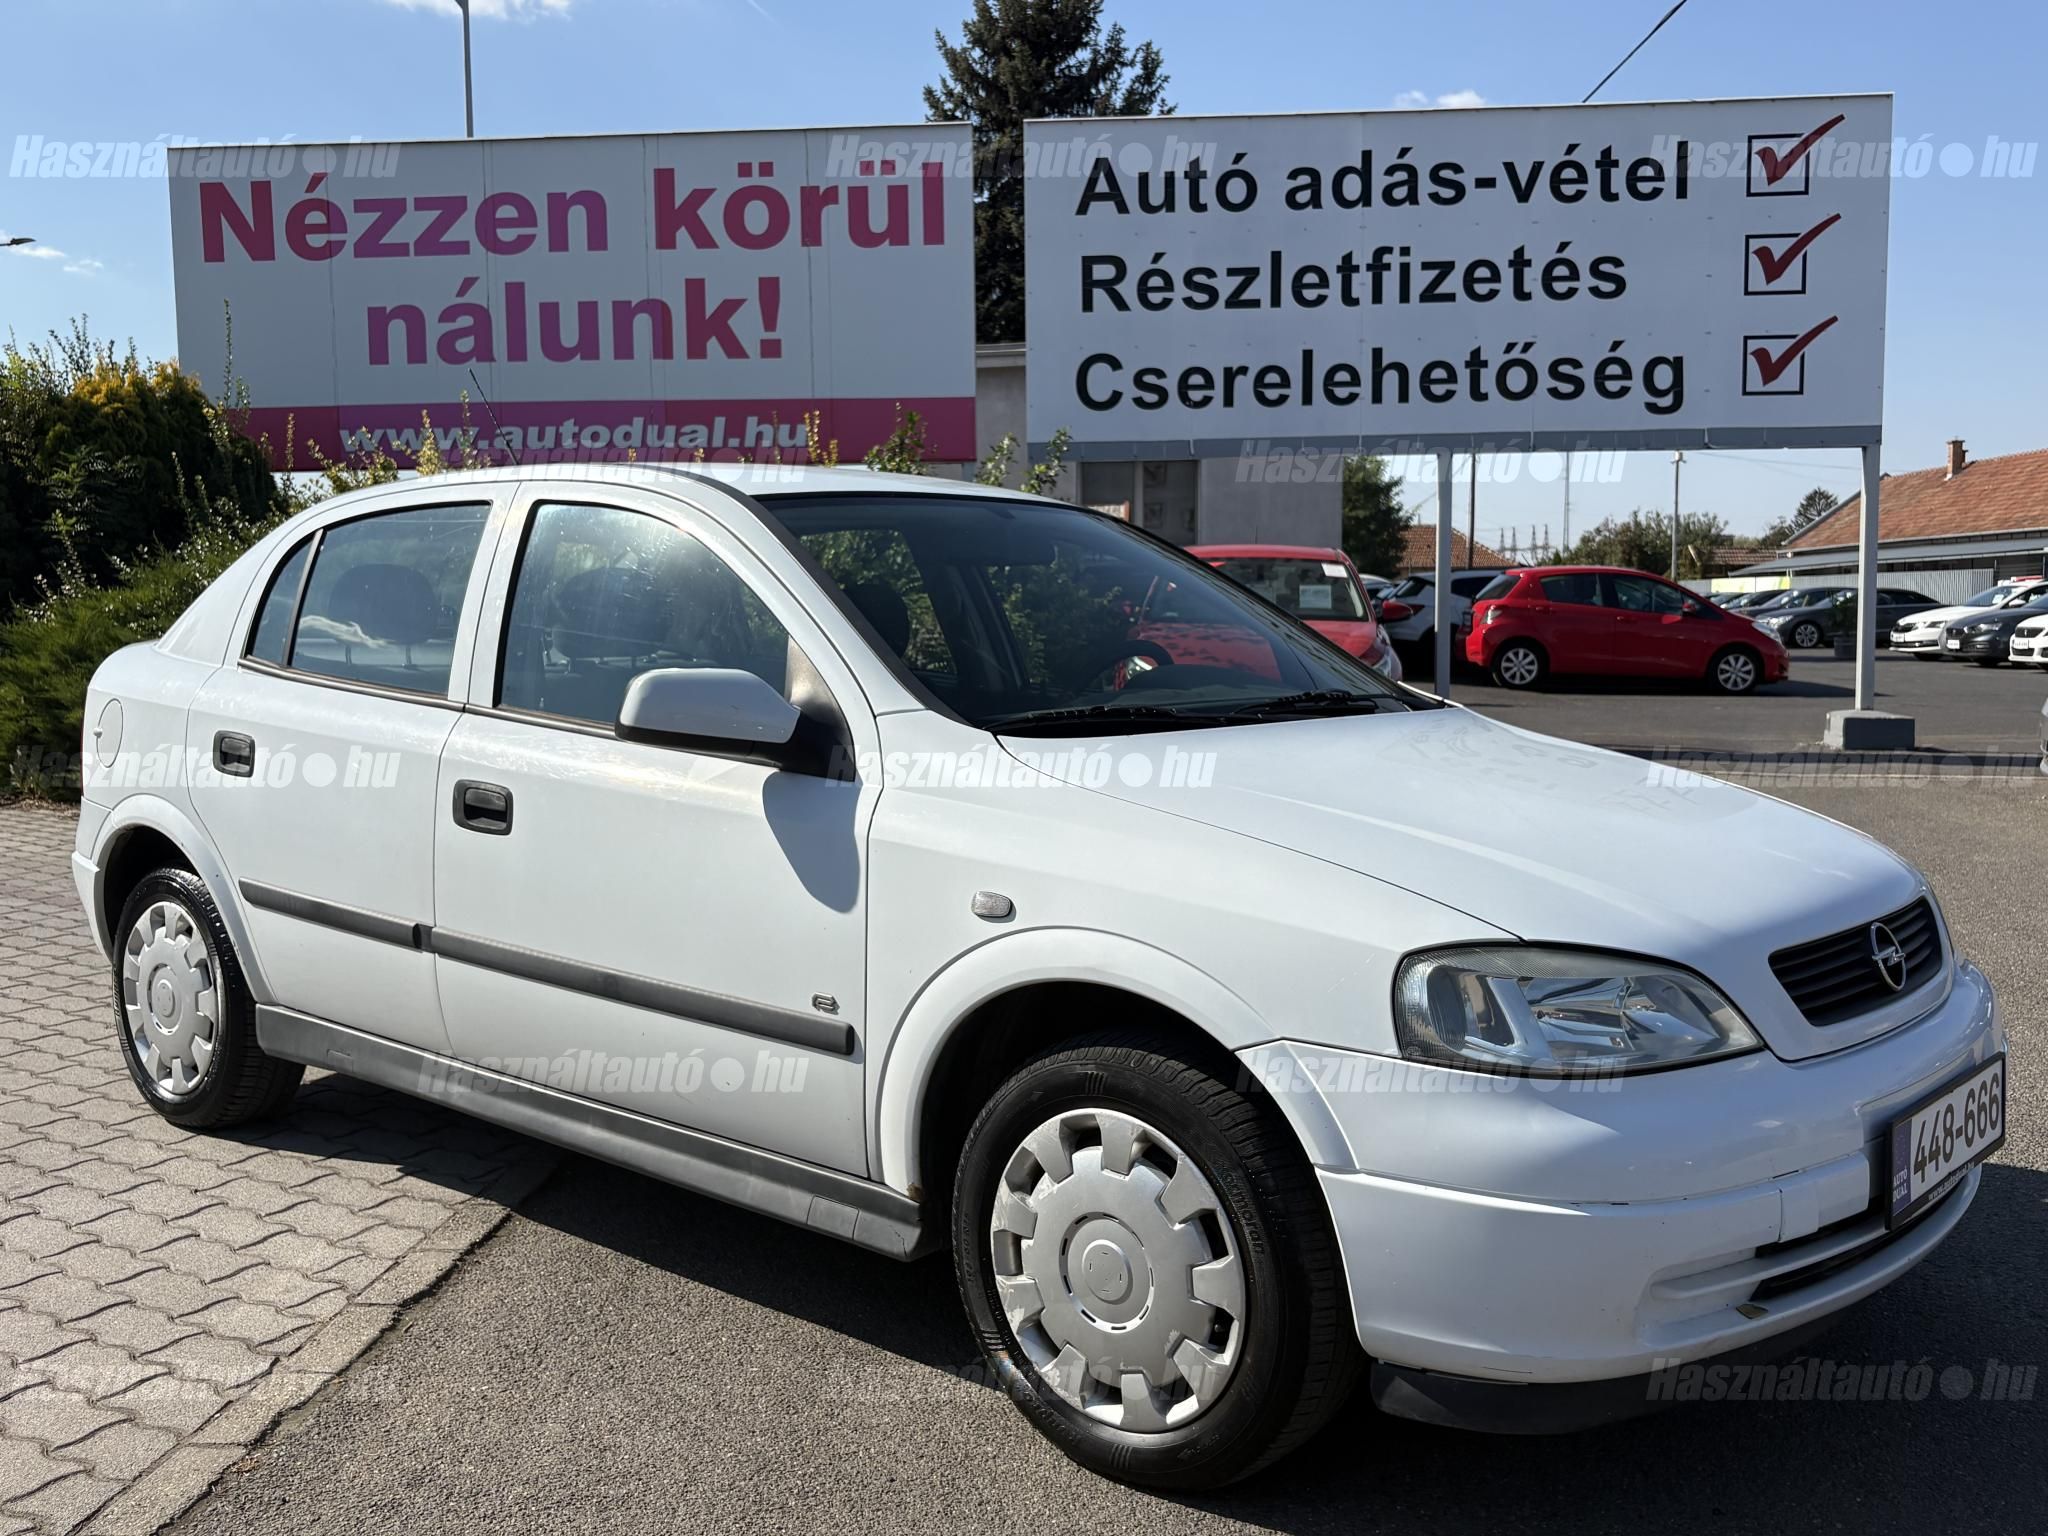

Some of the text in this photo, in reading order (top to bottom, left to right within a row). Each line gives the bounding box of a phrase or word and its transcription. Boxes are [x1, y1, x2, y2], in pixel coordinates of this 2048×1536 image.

[201, 160, 946, 262] Nézzen körül
[1075, 140, 1690, 216] Autó adás-vétel
[1081, 241, 1628, 314] Részletfizetés
[368, 277, 782, 366] nálunk!
[1076, 340, 1685, 415] Cserelehetőség
[340, 415, 809, 452] www.autodual.hu
[1913, 1072, 2000, 1183] 448-666
